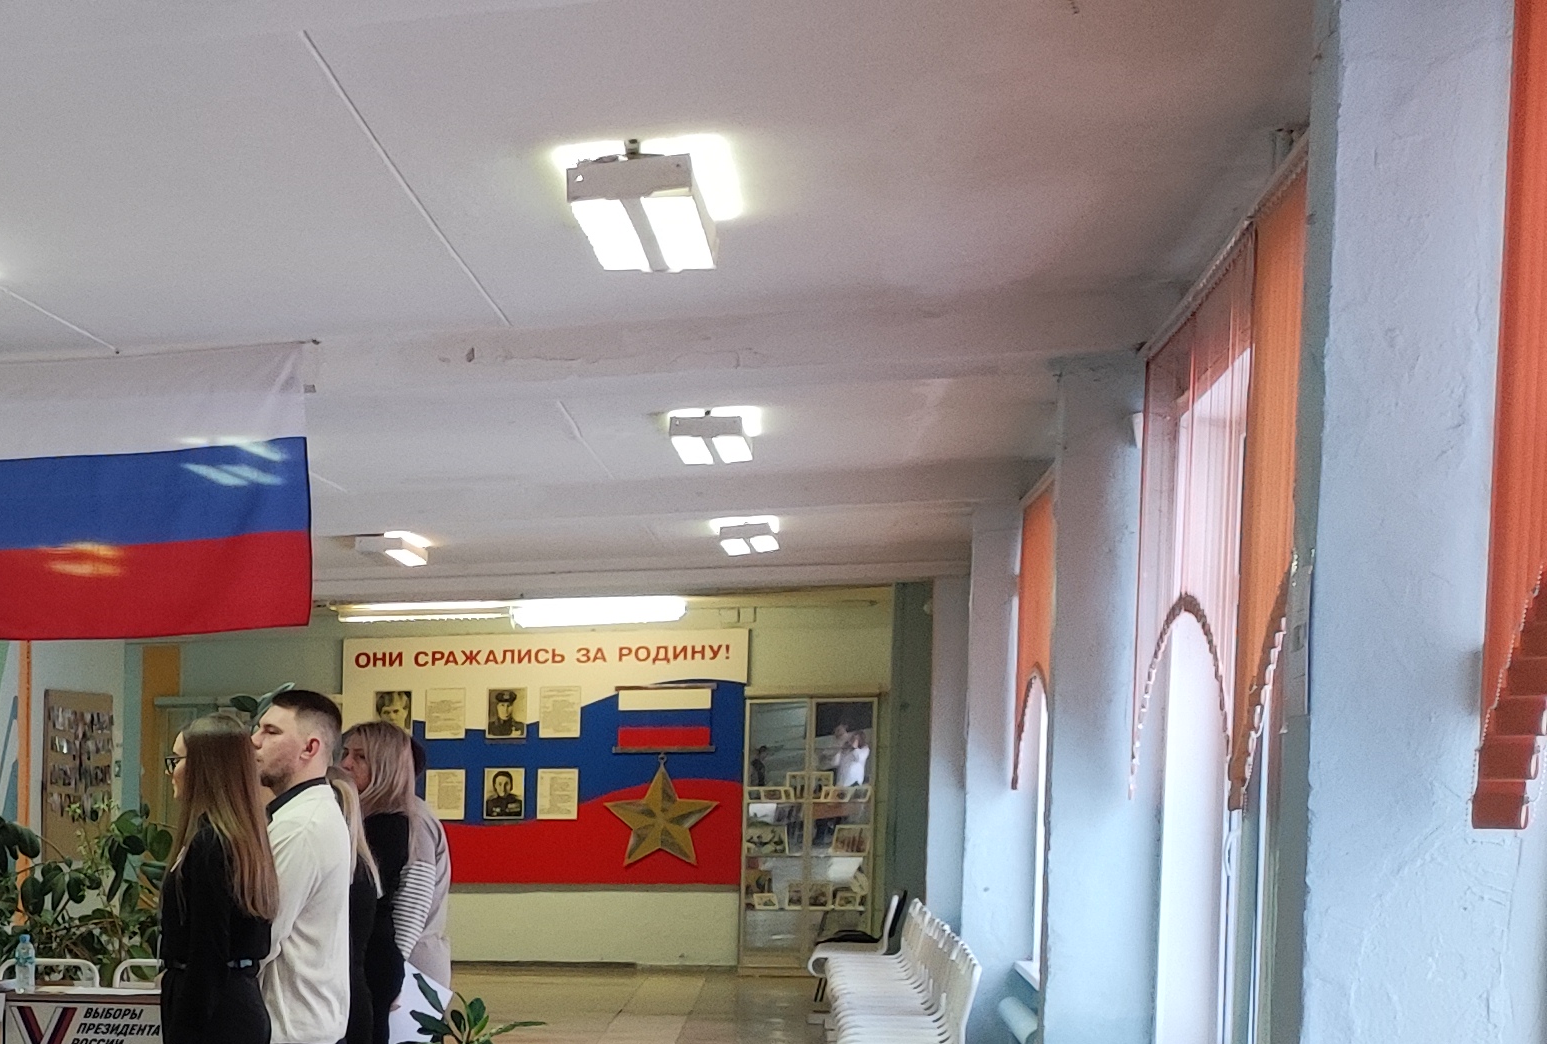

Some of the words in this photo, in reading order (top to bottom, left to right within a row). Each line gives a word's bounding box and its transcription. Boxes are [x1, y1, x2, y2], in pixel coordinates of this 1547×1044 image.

[354, 651, 404, 669] ОНИ
[413, 648, 566, 668] СРАЖАЛИСЬ
[575, 647, 608, 664] ЗА
[618, 643, 732, 665] РОДИНУ!
[83, 1007, 144, 1020] ВЫБОРЫ
[76, 1022, 162, 1038] ПРЕЗИДЕНТА
